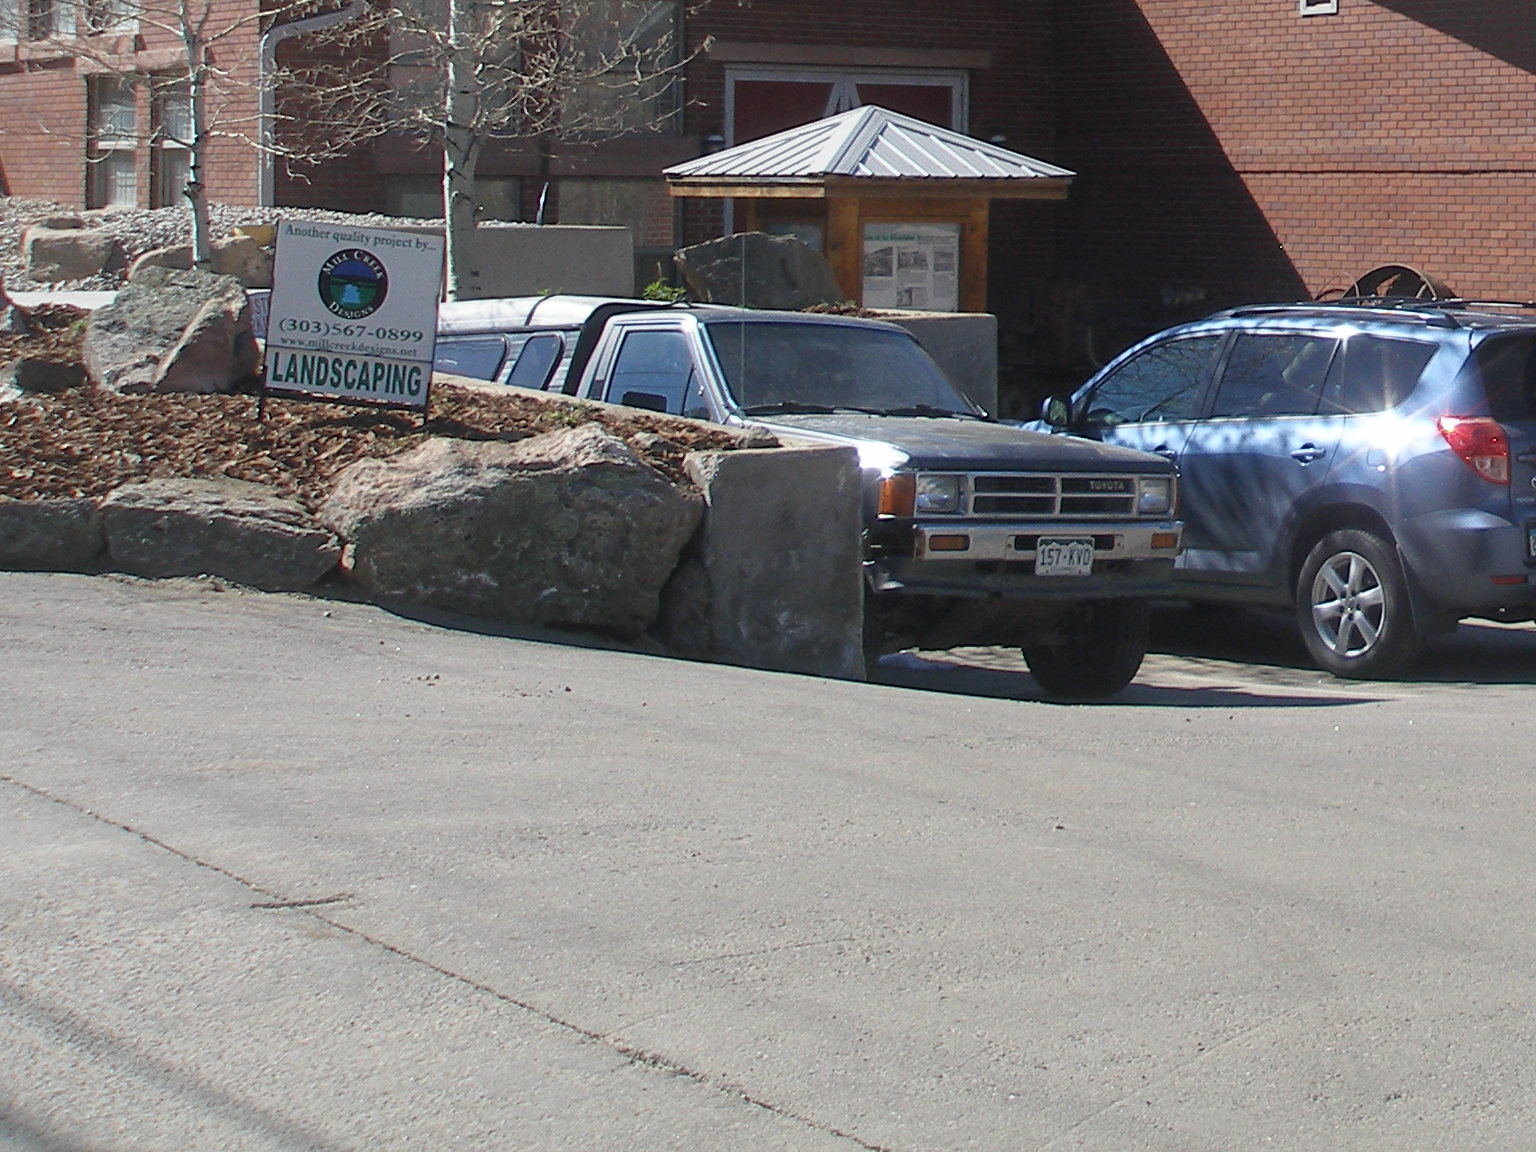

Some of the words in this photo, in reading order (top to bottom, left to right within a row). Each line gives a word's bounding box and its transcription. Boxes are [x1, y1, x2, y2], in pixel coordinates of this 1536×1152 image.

[285, 224, 330, 240] Another
[332, 231, 372, 246] quality
[373, 234, 412, 249] project
[279, 318, 424, 342] (303)567-0899
[280, 336, 418, 357] www.millcreekdesigns.net
[272, 351, 422, 396] LANDSCAPING
[1089, 480, 1125, 490] TOYOTA
